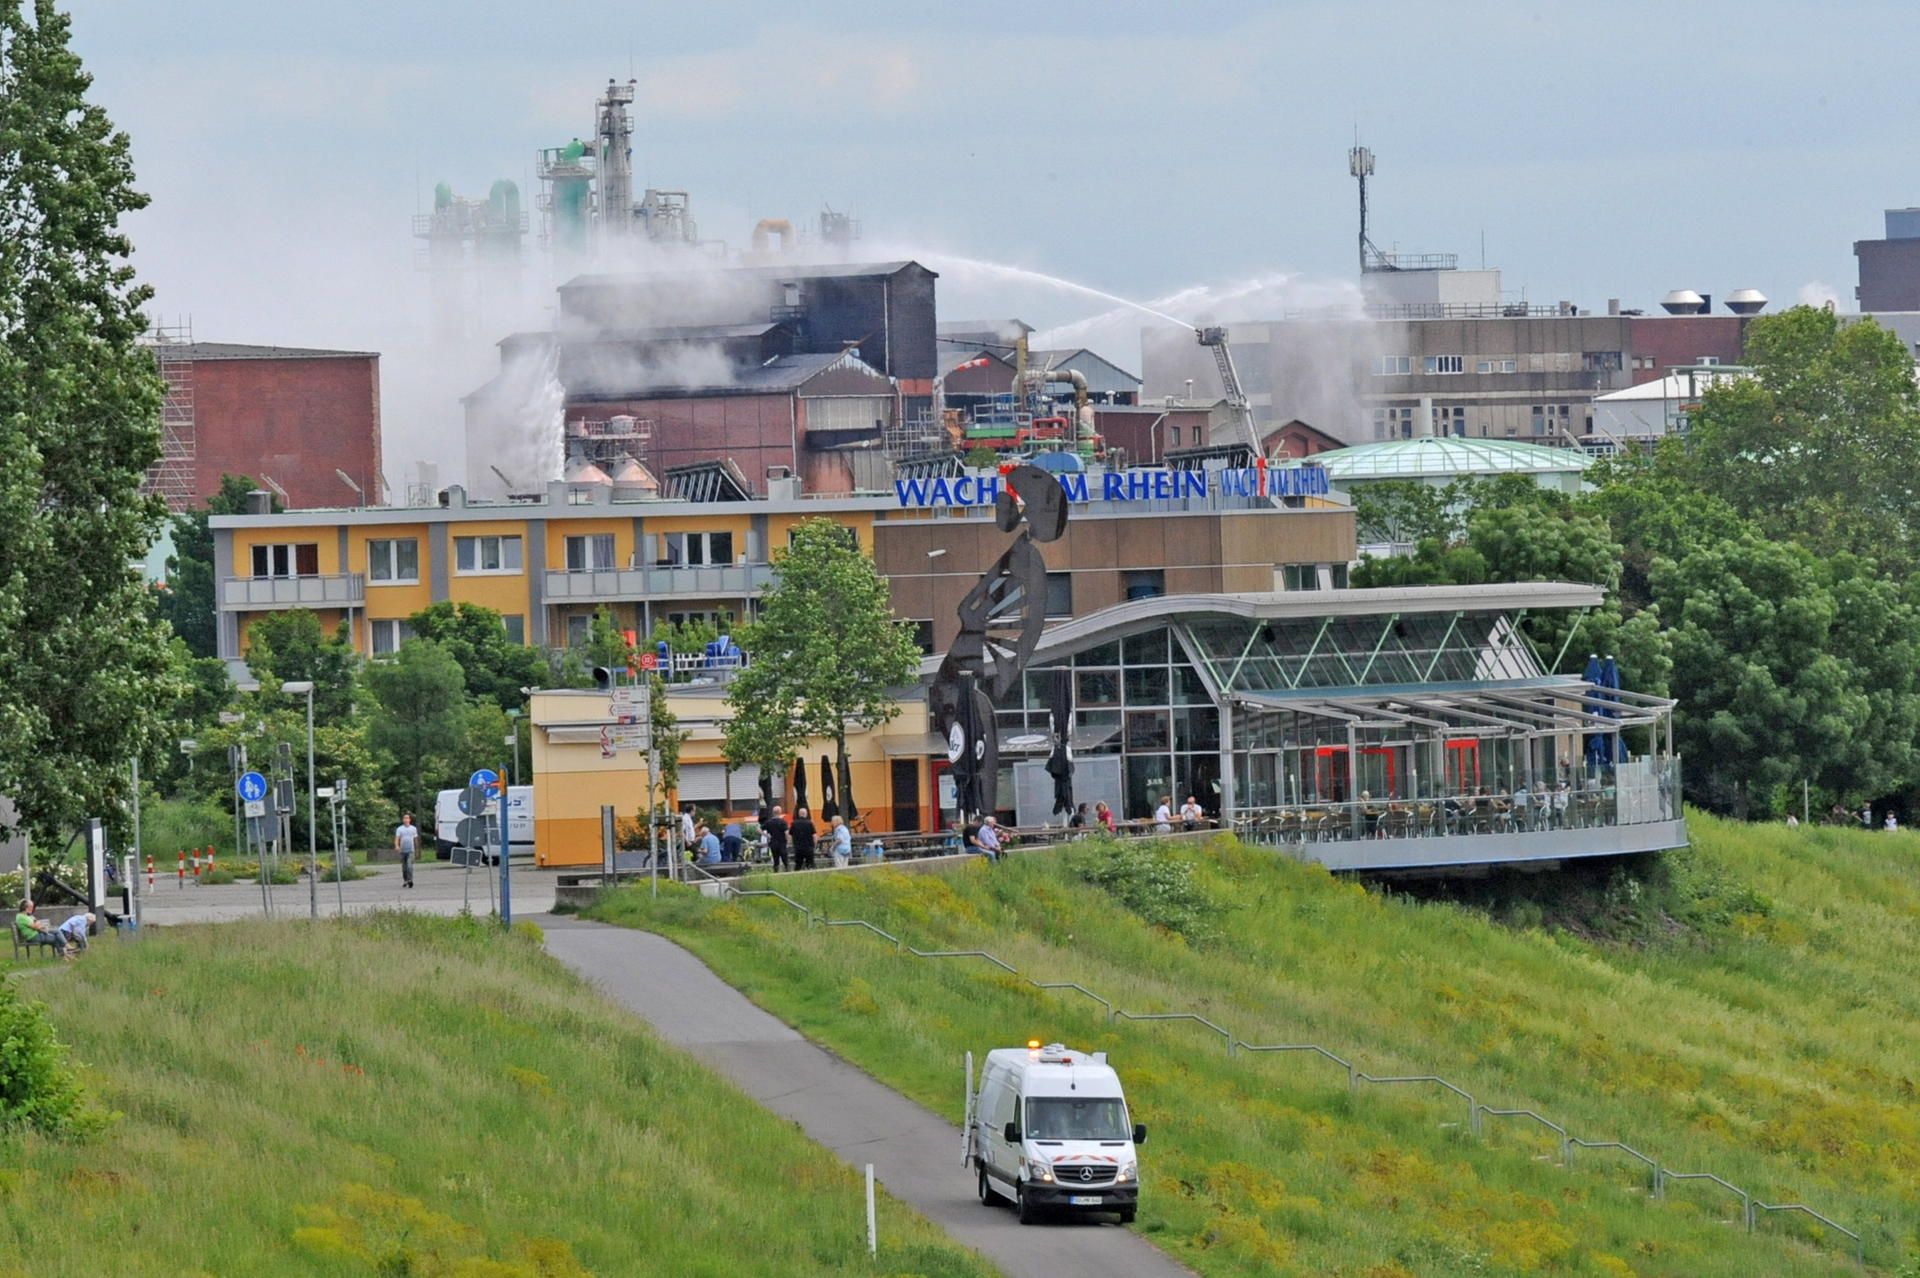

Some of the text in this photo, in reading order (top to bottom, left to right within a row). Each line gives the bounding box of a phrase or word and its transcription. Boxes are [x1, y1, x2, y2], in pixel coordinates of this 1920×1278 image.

[1058, 472, 1089, 501] M
[1103, 469, 1208, 500] RHEIN
[1268, 469, 1288, 494] AM
[1293, 467, 1328, 494] RHEIN
